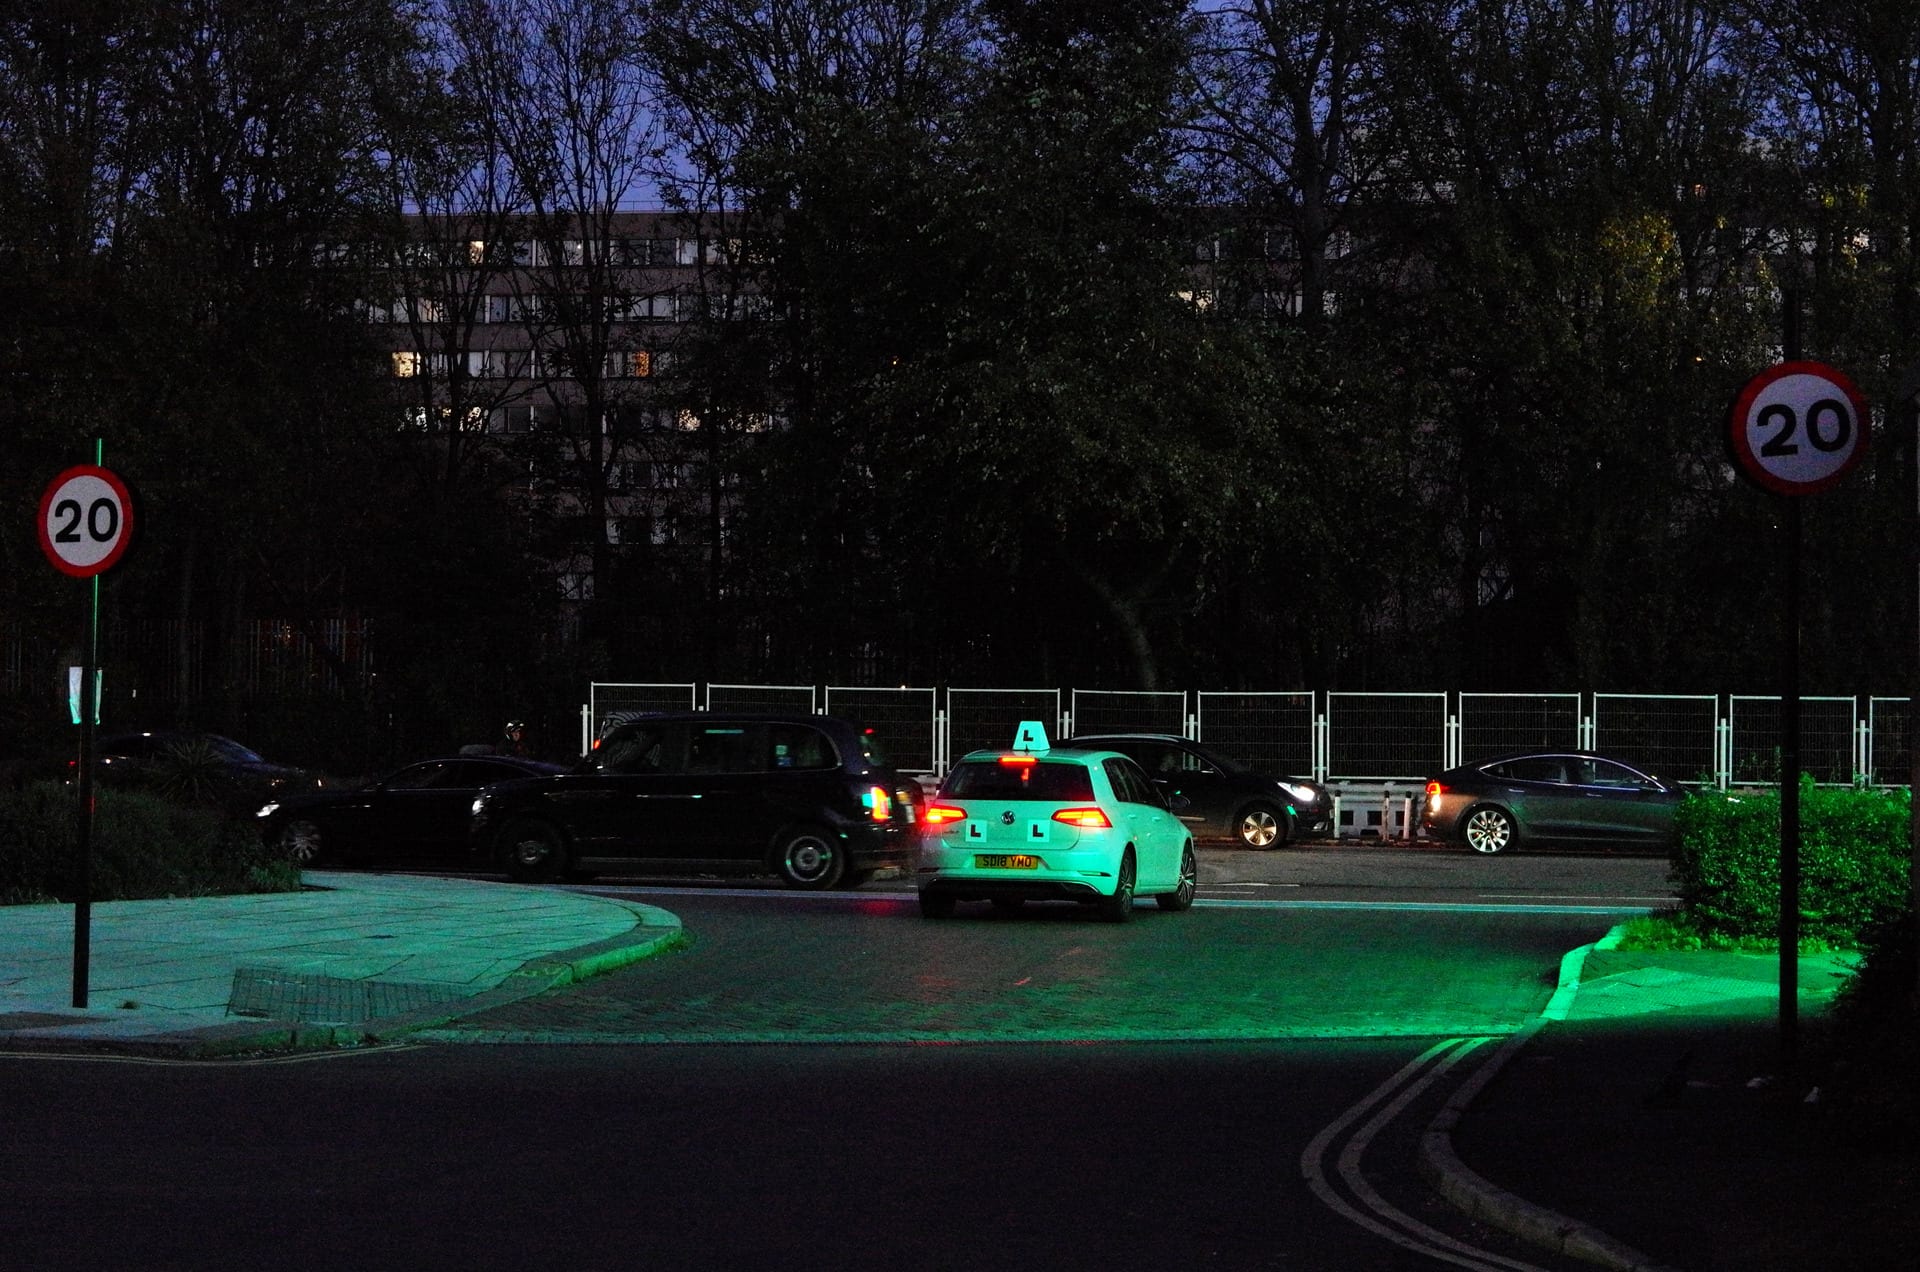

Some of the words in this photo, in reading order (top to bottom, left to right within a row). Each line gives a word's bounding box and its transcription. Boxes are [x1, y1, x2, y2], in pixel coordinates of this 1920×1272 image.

[1757, 399, 1850, 457] 20
[55, 498, 118, 543] 20
[1023, 730, 1034, 742] L
[970, 824, 981, 837] L
[1032, 824, 1044, 837] L
